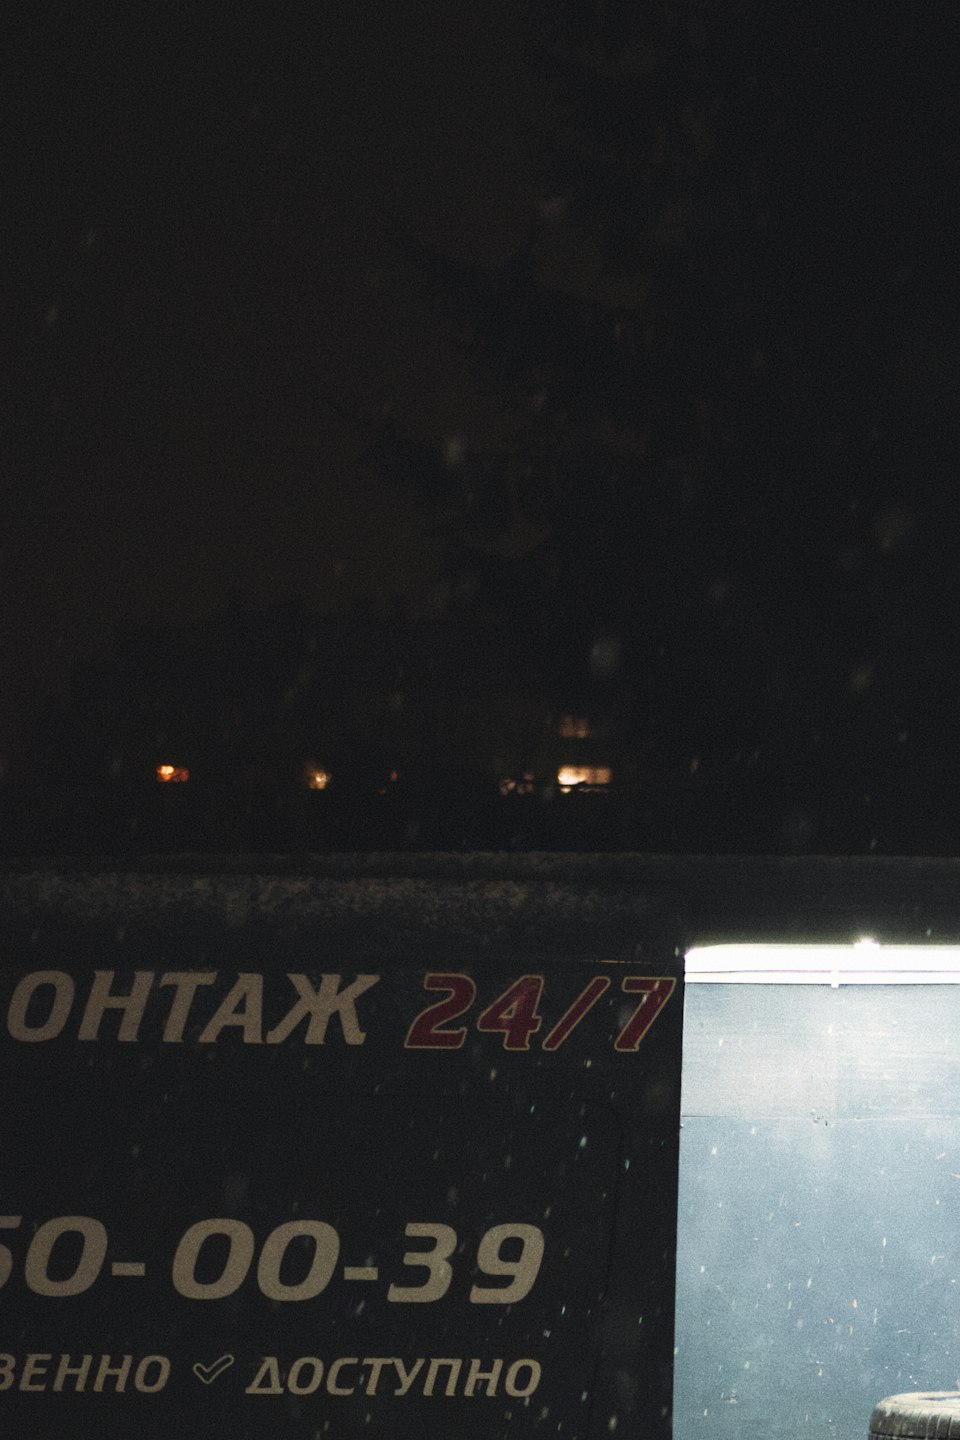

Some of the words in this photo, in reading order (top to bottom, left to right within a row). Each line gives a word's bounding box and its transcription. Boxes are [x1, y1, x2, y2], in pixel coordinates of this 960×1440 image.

[6, 969, 381, 1046] ОНТАЖ
[403, 972, 677, 1052] 24/7
[245, 1355, 542, 1398] ДОСТУПНО
